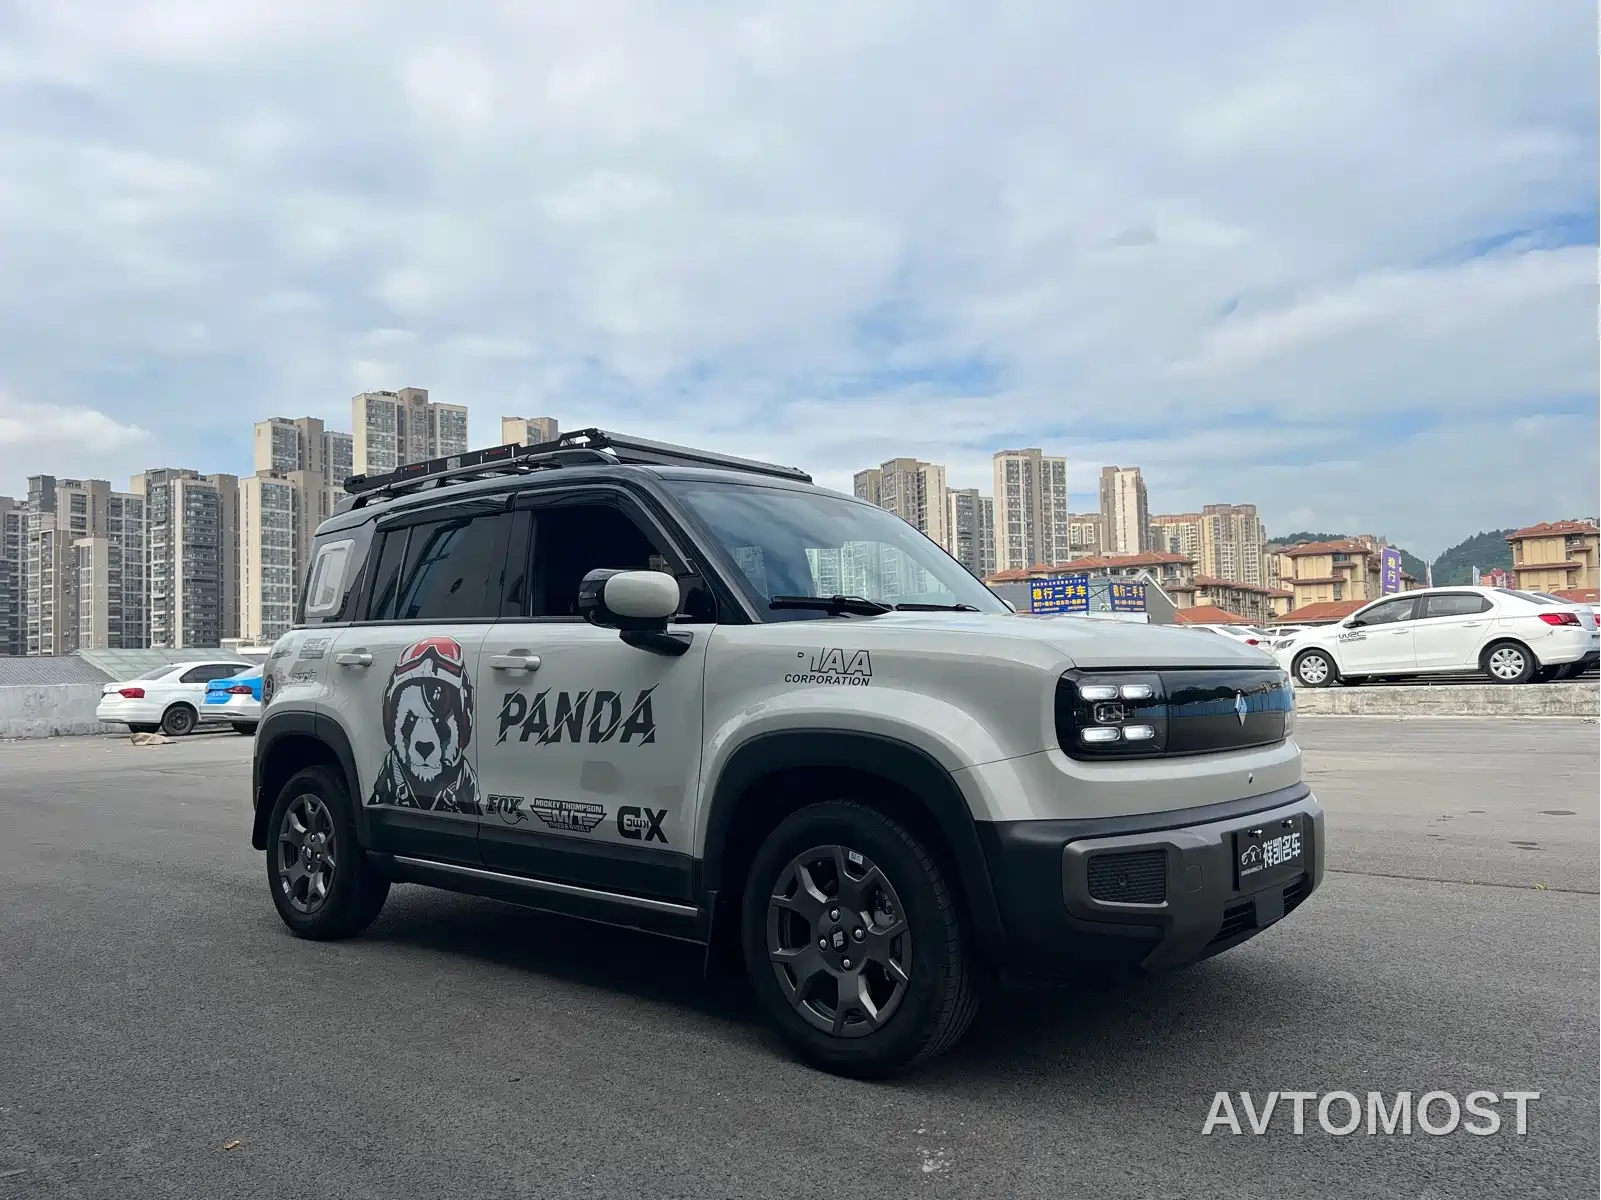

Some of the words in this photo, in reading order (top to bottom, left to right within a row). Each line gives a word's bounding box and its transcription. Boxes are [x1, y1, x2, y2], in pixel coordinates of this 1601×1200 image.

[784, 673, 870, 687] CORPORATION
[495, 684, 659, 746] PANDA
[486, 794, 525, 815] FOX
[535, 799, 560, 809] MICKEY
[562, 802, 602, 814] THOMPSON
[1262, 832, 1300, 868] 祥凯名车
